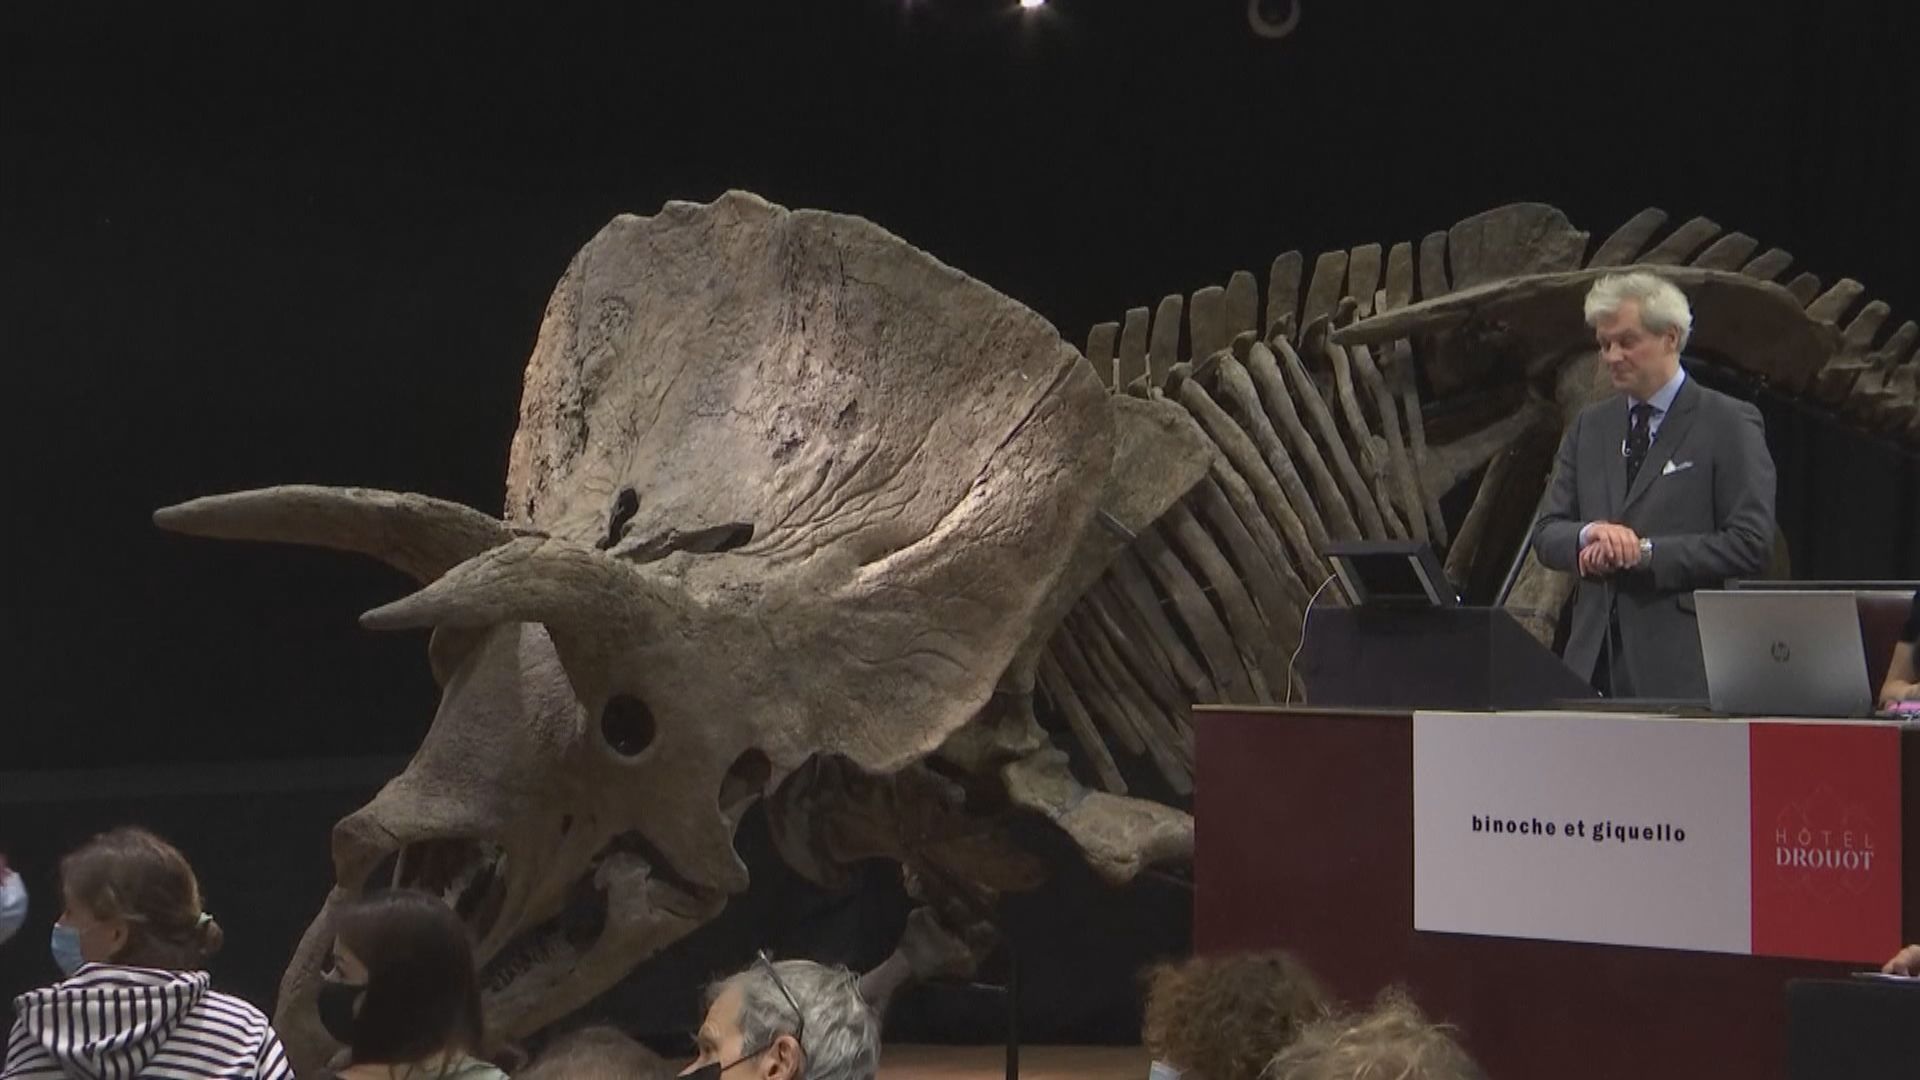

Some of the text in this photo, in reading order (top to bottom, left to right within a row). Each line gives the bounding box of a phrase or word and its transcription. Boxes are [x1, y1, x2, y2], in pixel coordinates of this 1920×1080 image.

[1472, 815, 1686, 843] binoche et giquello
[1776, 827, 1873, 848] HÔTEL
[1776, 847, 1874, 870] DROUOT
